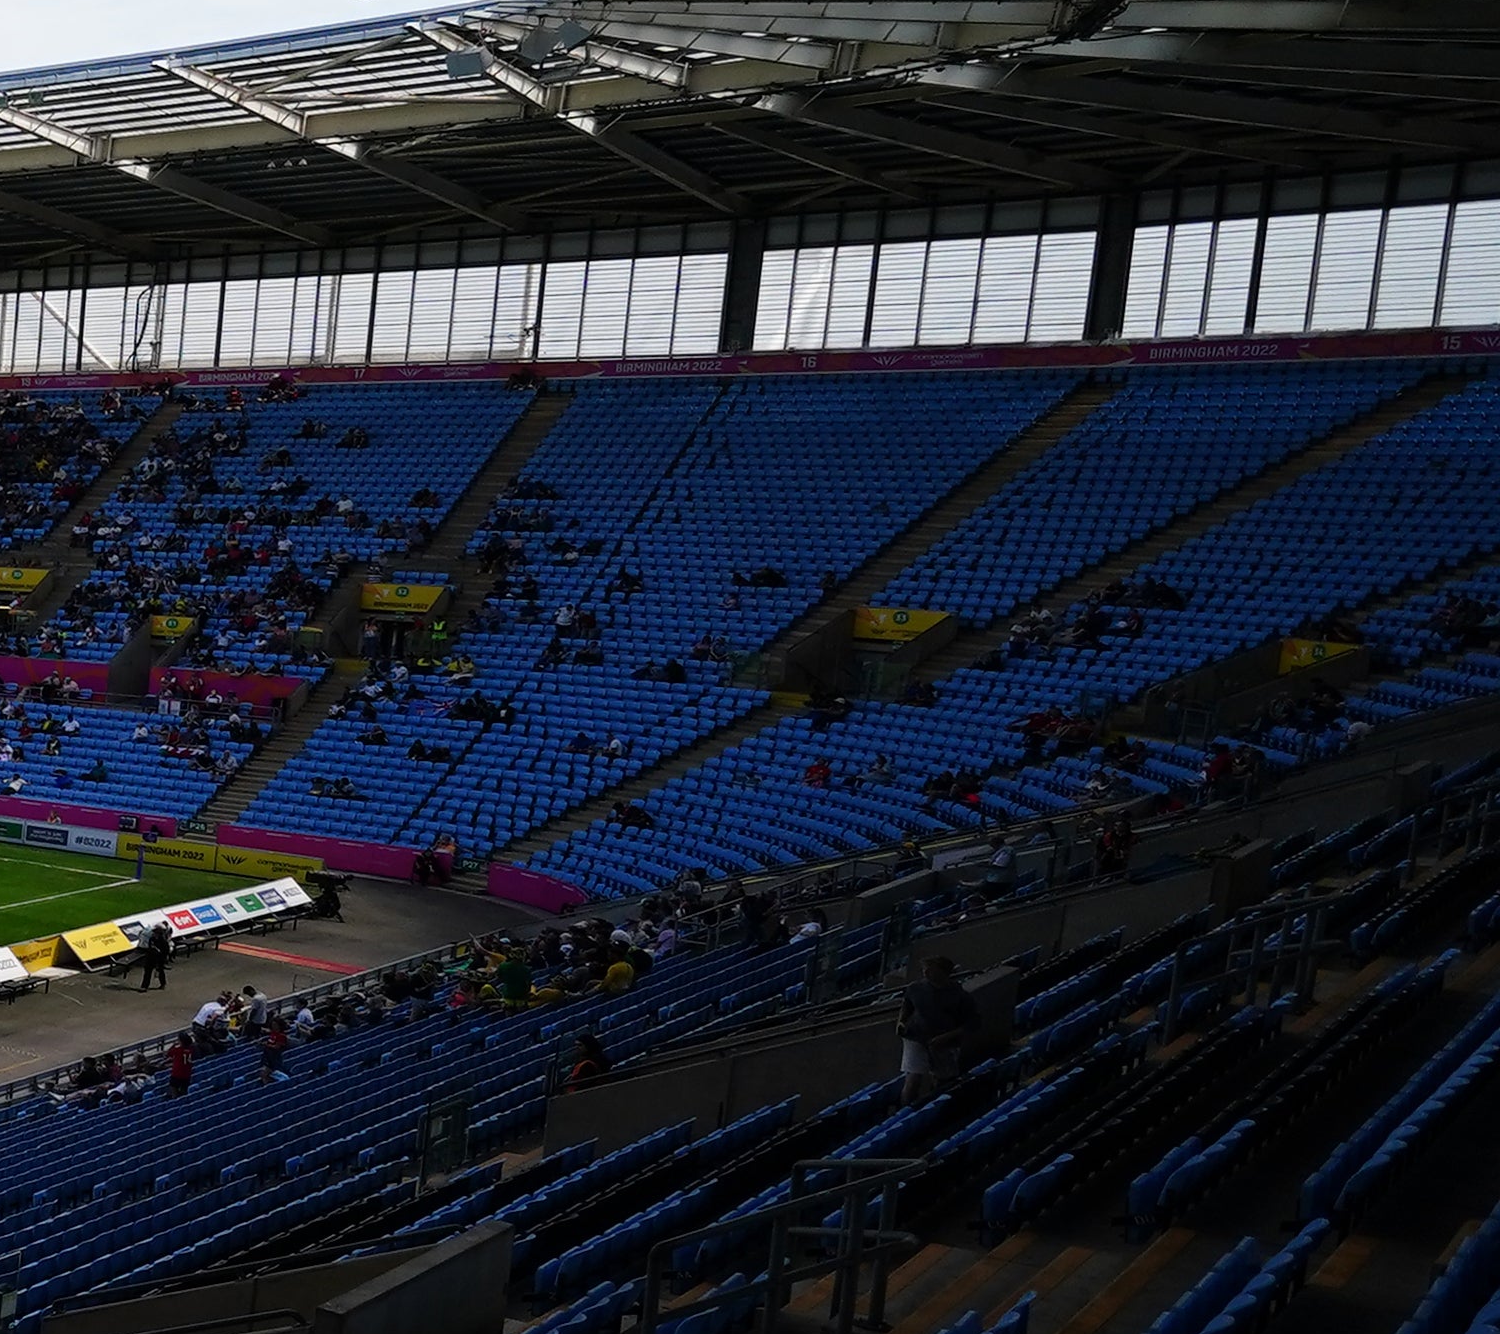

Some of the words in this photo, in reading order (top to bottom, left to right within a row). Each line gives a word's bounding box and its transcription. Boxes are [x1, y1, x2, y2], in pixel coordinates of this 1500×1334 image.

[1442, 336, 1461, 350] 15
[1150, 346, 1239, 360] BIRMINGHAM
[1242, 344, 1278, 357] 2022
[615, 363, 690, 373] BIRMINGHAM
[692, 361, 723, 371] 2022
[801, 356, 817, 368] 16
[199, 373, 257, 382] BIRMINGHAM
[353, 369, 365, 379] 17
[189, 821, 206, 831] P26
[75, 835, 112, 849] #B2022
[182, 850, 205, 861] 2022
